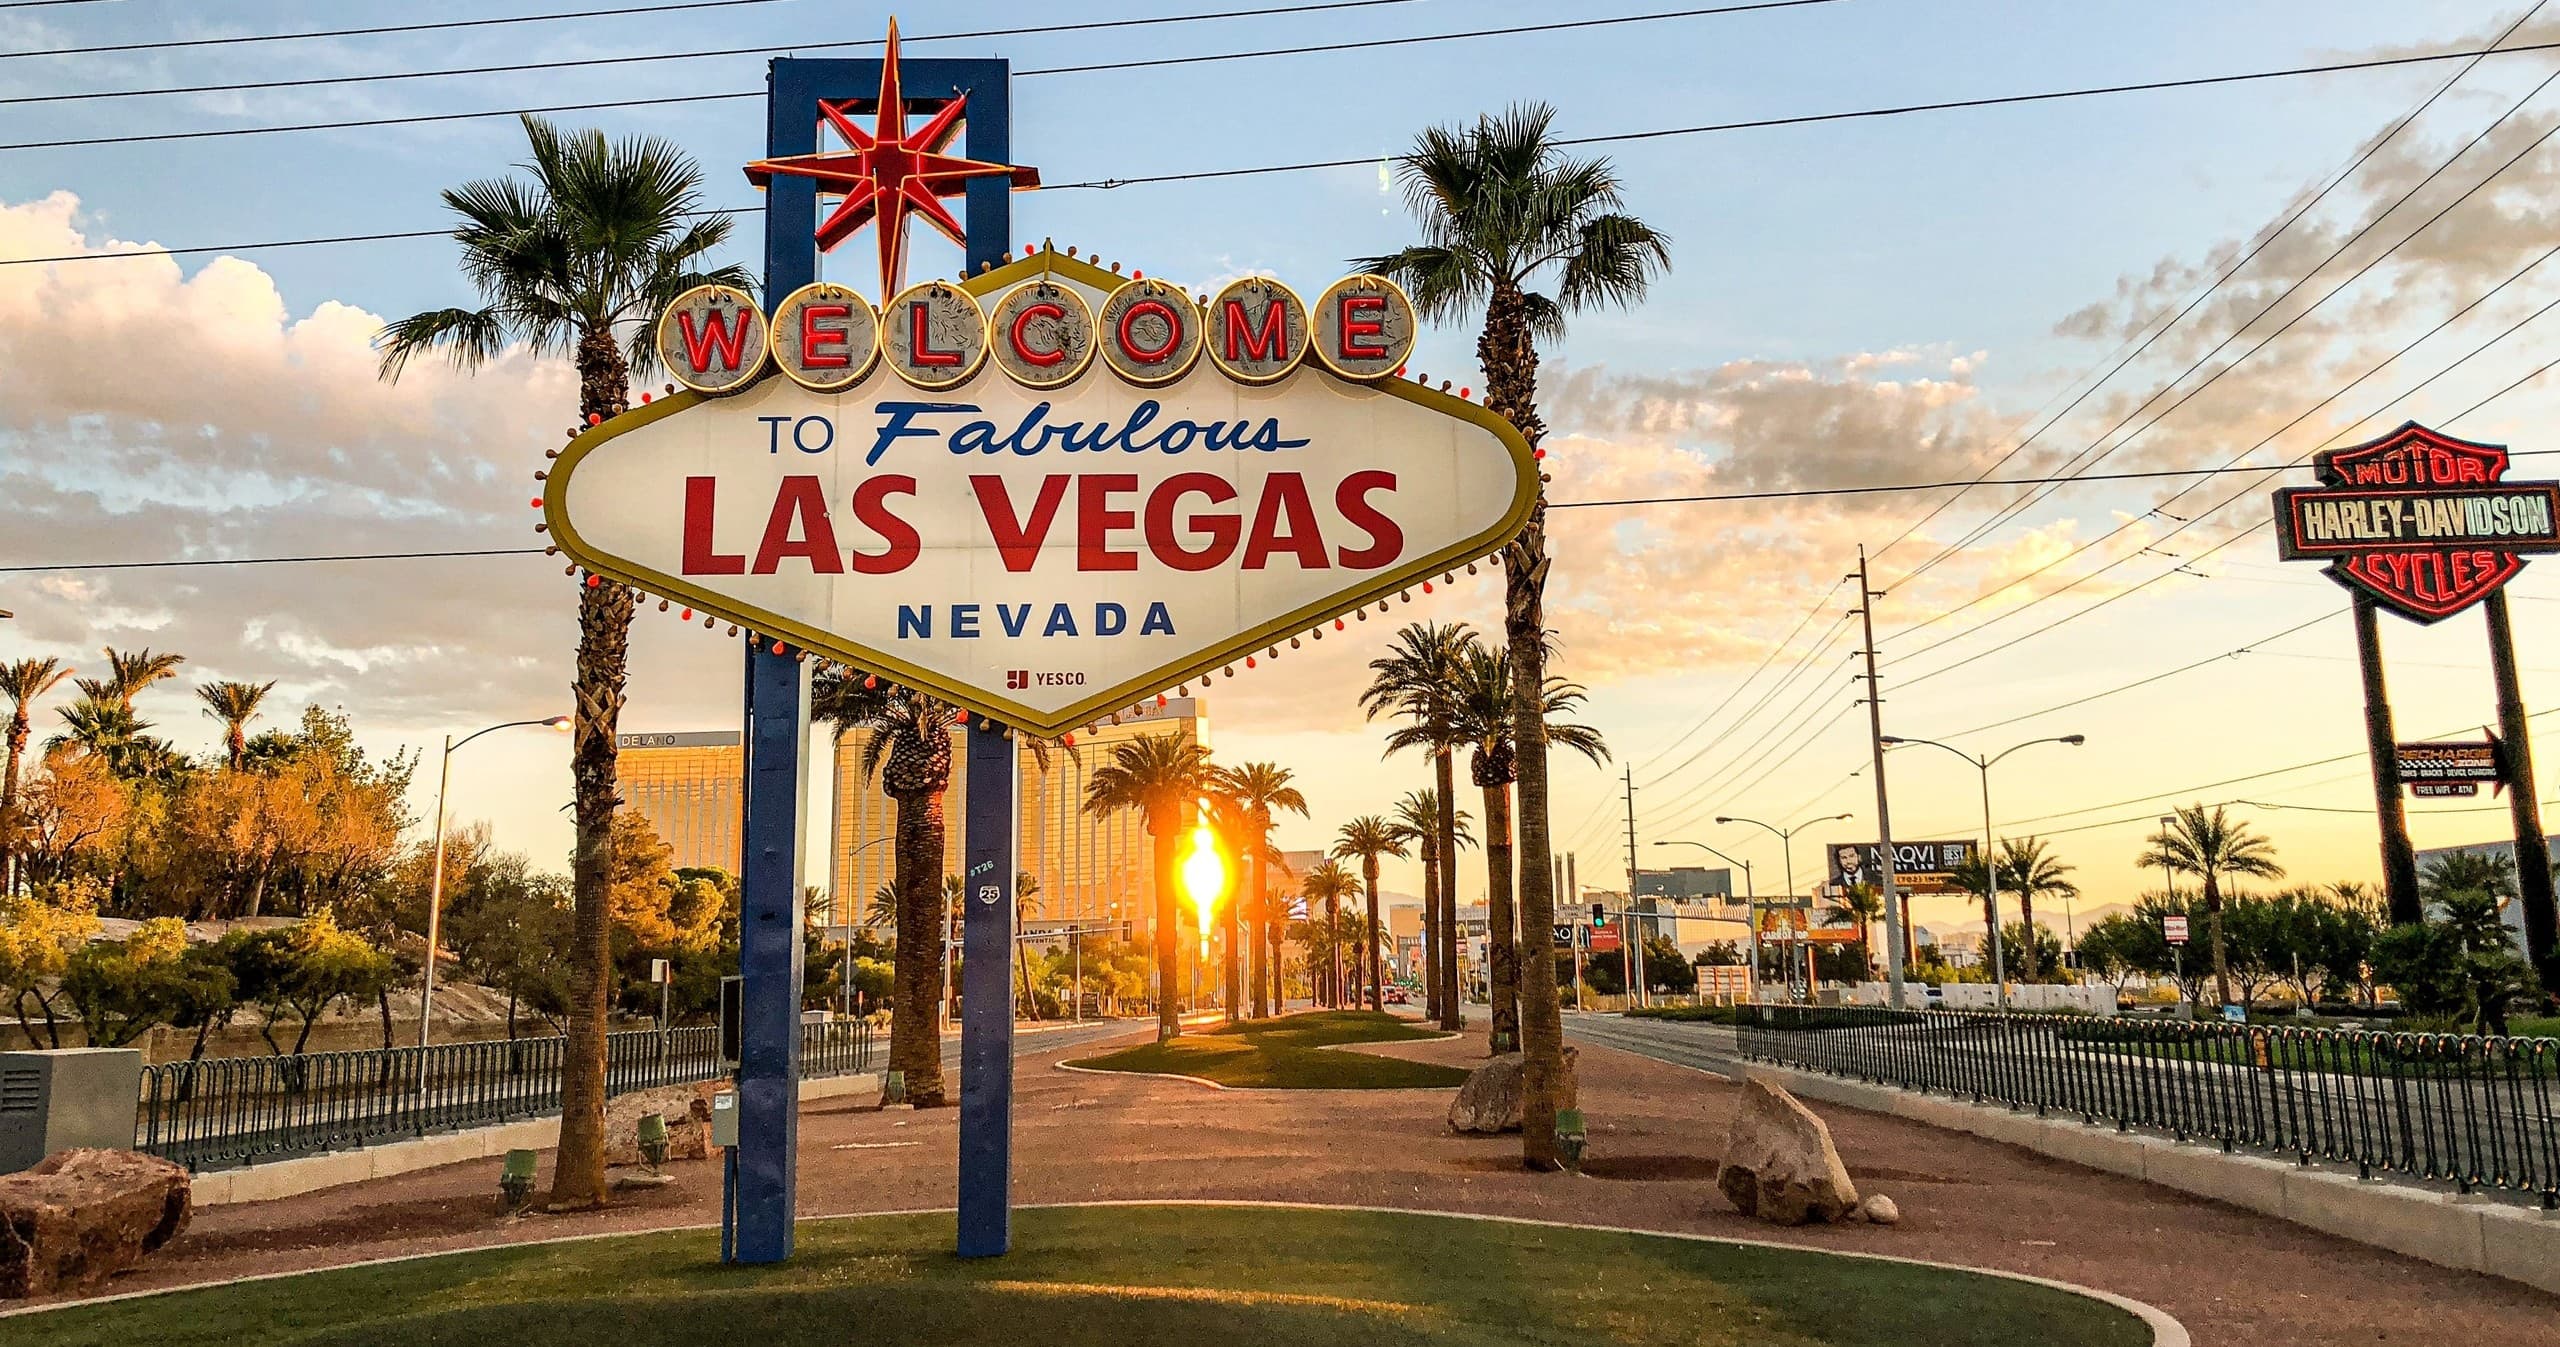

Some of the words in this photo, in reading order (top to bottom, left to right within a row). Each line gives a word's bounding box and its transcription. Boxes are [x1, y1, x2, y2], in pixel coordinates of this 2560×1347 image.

[678, 296, 1388, 372] WELCOME
[758, 417, 833, 454] TO
[866, 400, 1309, 467] Fabulous
[2355, 440, 2486, 484] MOTOR
[682, 474, 922, 577] LAS
[969, 470, 1405, 573] VEGAS
[2304, 495, 2550, 540] HARLEY-DAVIDSON
[2366, 551, 2498, 602] CYCLES
[897, 602, 1174, 639] NEVADA
[621, 735, 676, 746] DELANO
[981, 889, 999, 899] 25
